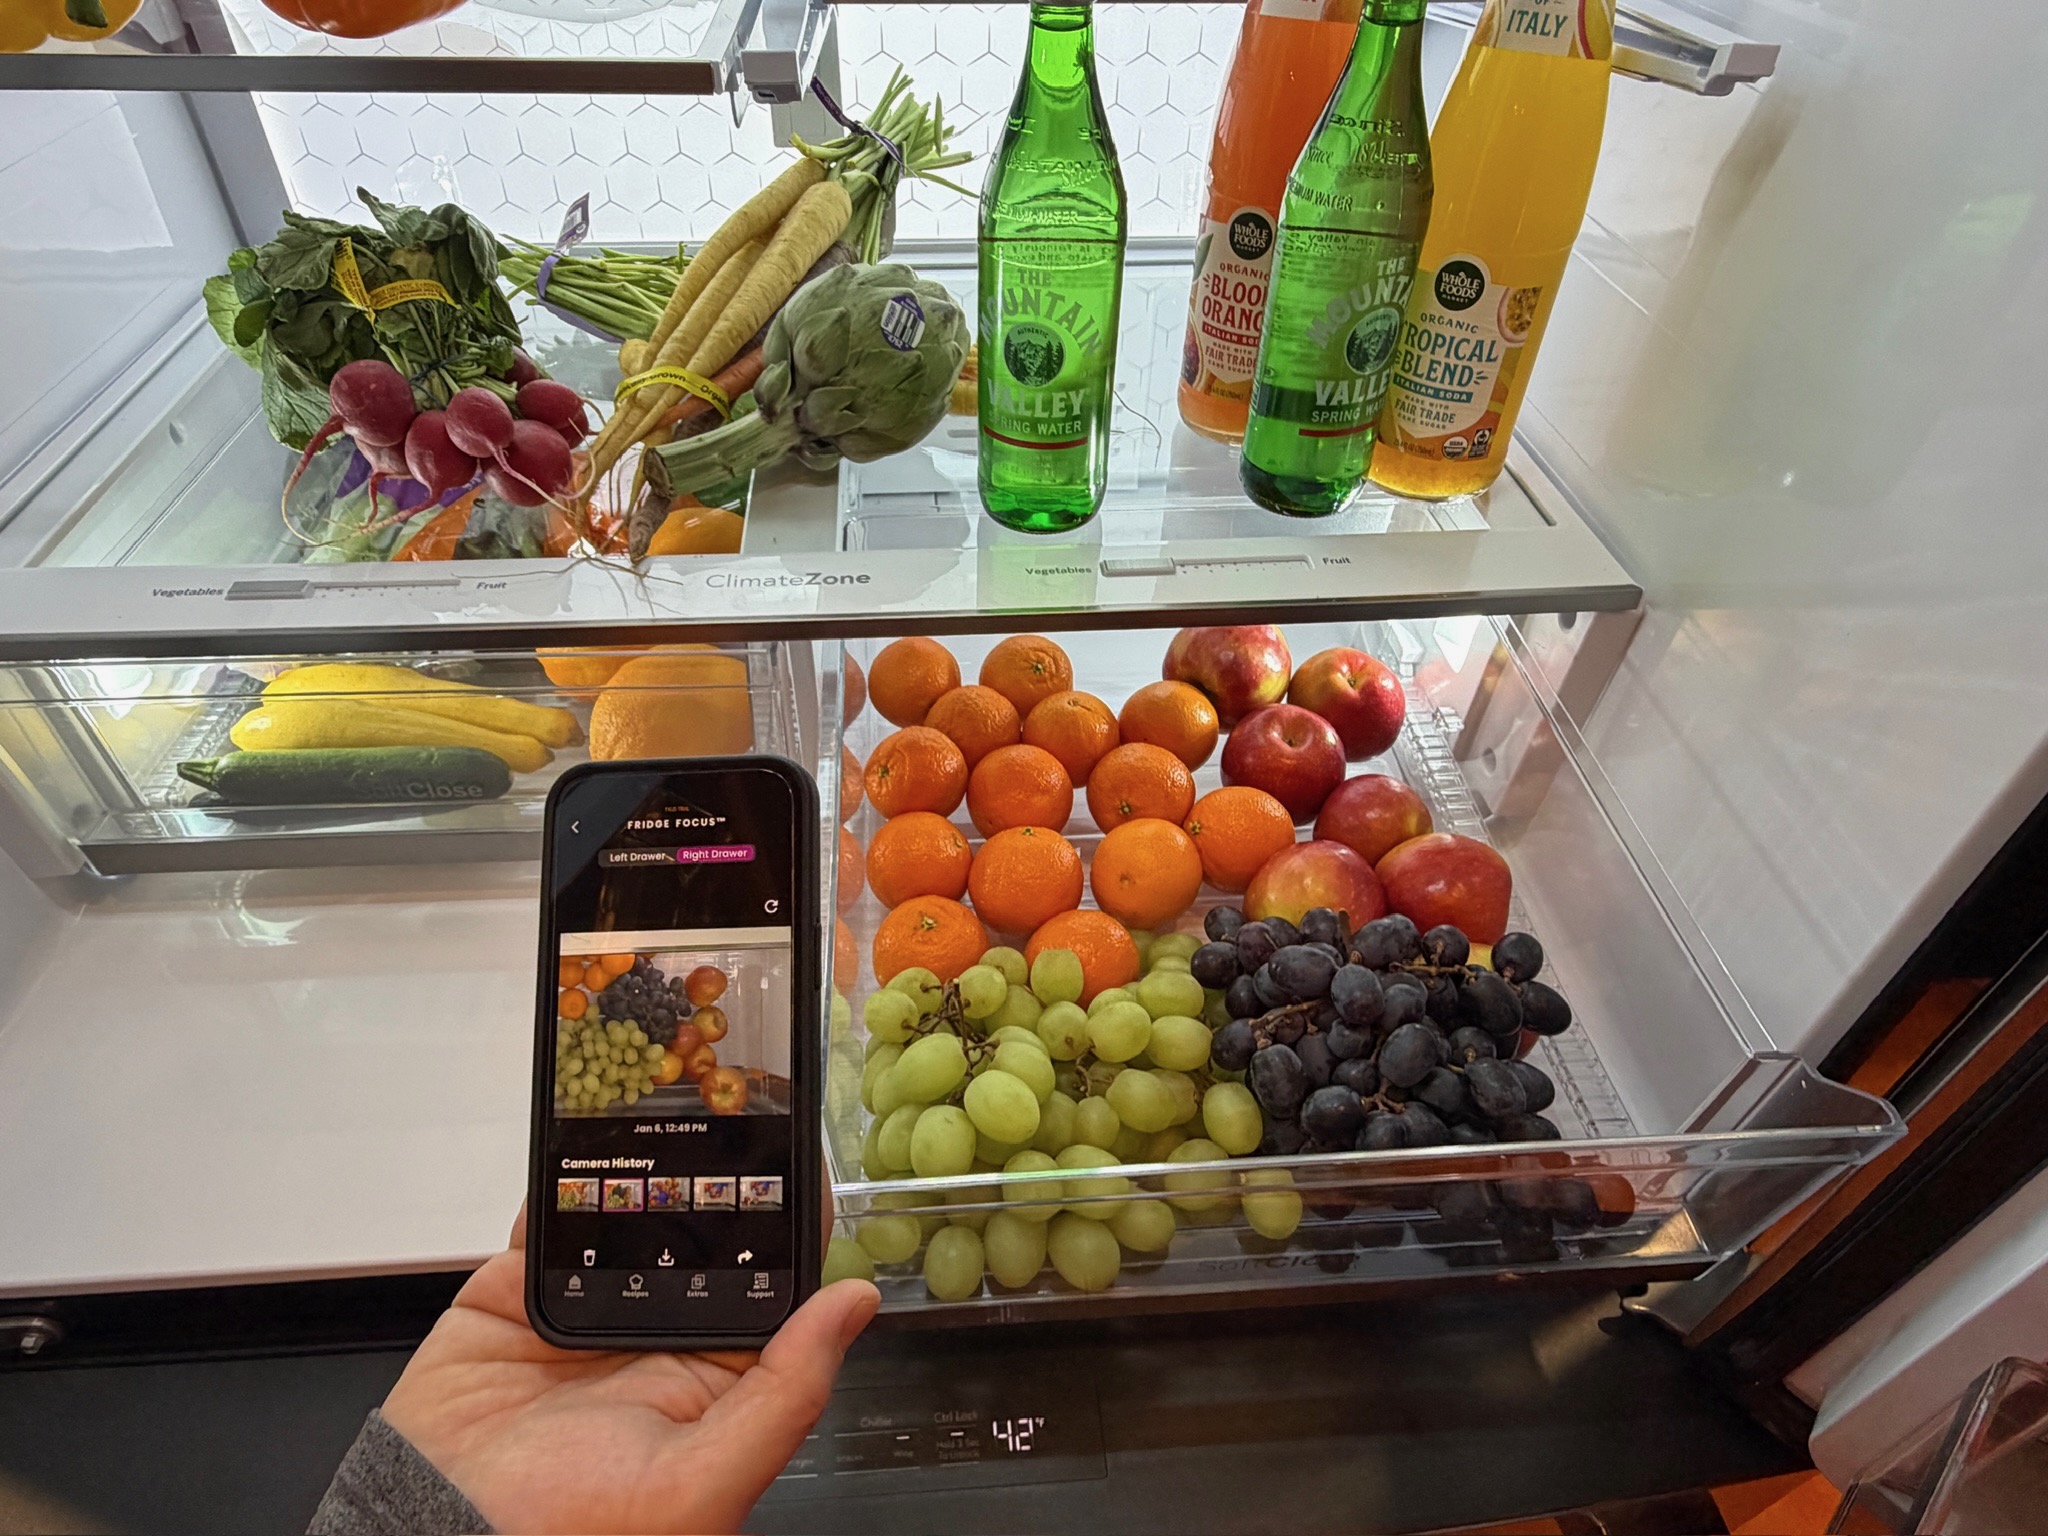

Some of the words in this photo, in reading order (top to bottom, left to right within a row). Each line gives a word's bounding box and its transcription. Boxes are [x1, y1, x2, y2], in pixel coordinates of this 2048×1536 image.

[1506, 9, 1568, 38] ITALY
[1234, 223, 1269, 240] WHOLE
[1234, 234, 1266, 248] FOODS
[1219, 262, 1270, 280] ORGANIC
[1377, 256, 1406, 277] THE
[1018, 269, 1052, 286] THE
[1441, 272, 1481, 290] WHOLE
[1440, 284, 1477, 299] FOODS
[1420, 312, 1478, 334] ORGANIC
[1204, 325, 1238, 342] ITALIAN
[1403, 320, 1499, 363] ROPICAL
[1205, 345, 1224, 362] FAIR
[1401, 349, 1474, 387] BLEND
[1396, 375, 1434, 395] ITALIAN
[1440, 391, 1468, 401] SODA
[987, 378, 1088, 419] VALLEY
[1405, 395, 1424, 405] MADE
[1429, 402, 1450, 410] WITH
[1311, 408, 1361, 424] SPRING
[1395, 398, 1417, 416] FAIR
[1418, 407, 1456, 424] TRADE
[1037, 420, 1082, 436] WATER
[1323, 556, 1351, 565] Fruit
[1025, 567, 1092, 576] Vegetables
[476, 581, 507, 589] Fruit
[706, 573, 872, 588] ClimateZone
[153, 588, 224, 598] Vegetables
[627, 819, 670, 830] FRIDGE
[610, 852, 628, 862] Left
[630, 852, 666, 862] Drawer
[683, 849, 709, 862] Right
[711, 848, 748, 859] Drawer
[633, 1124, 653, 1133] Jan
[655, 1123, 663, 1134] 6,
[665, 1123, 691, 1133] 12:49
[692, 1123, 708, 1132] PM
[561, 1158, 610, 1169] Camera
[612, 1157, 656, 1171] History
[747, 1290, 775, 1299] Support
